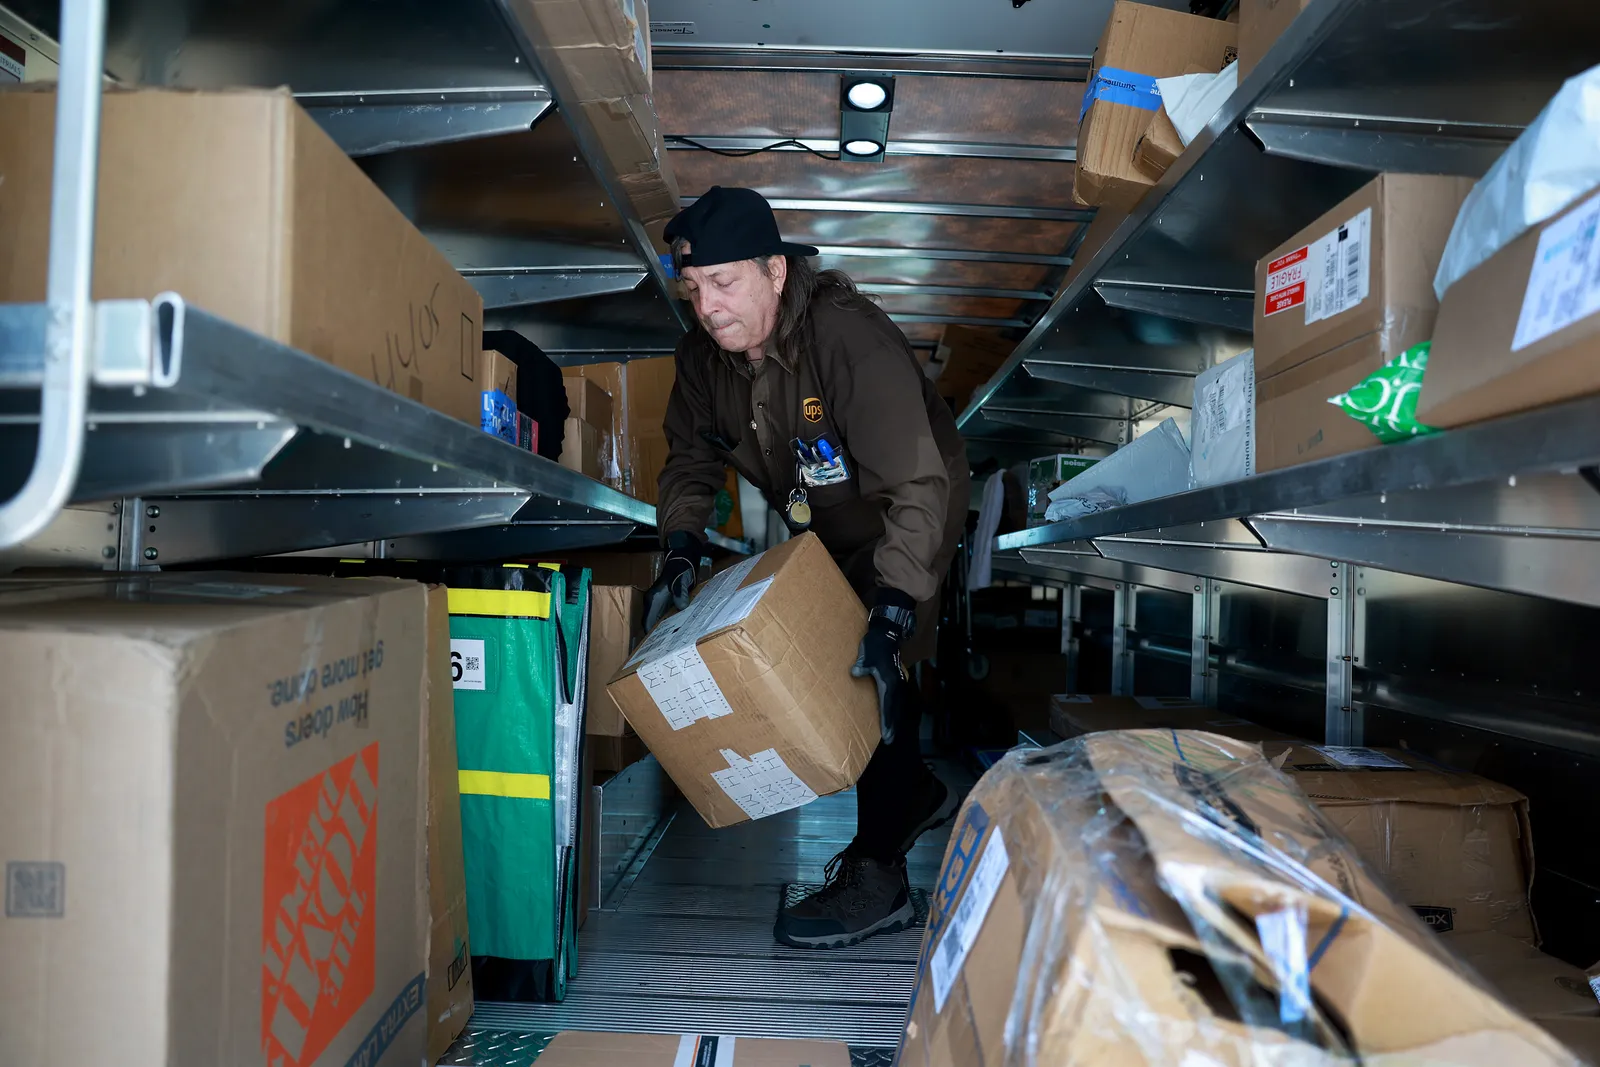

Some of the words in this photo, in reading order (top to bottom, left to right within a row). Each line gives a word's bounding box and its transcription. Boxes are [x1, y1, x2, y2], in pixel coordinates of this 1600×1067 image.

[1271, 265, 1302, 289] FRAGILE
[805, 405, 823, 419] ups
[321, 655, 360, 688] more
[362, 640, 384, 678] get
[450, 651, 463, 682] 6
[336, 689, 368, 723] How
[285, 704, 334, 749] doers
[380, 983, 420, 1044] EXTRA
